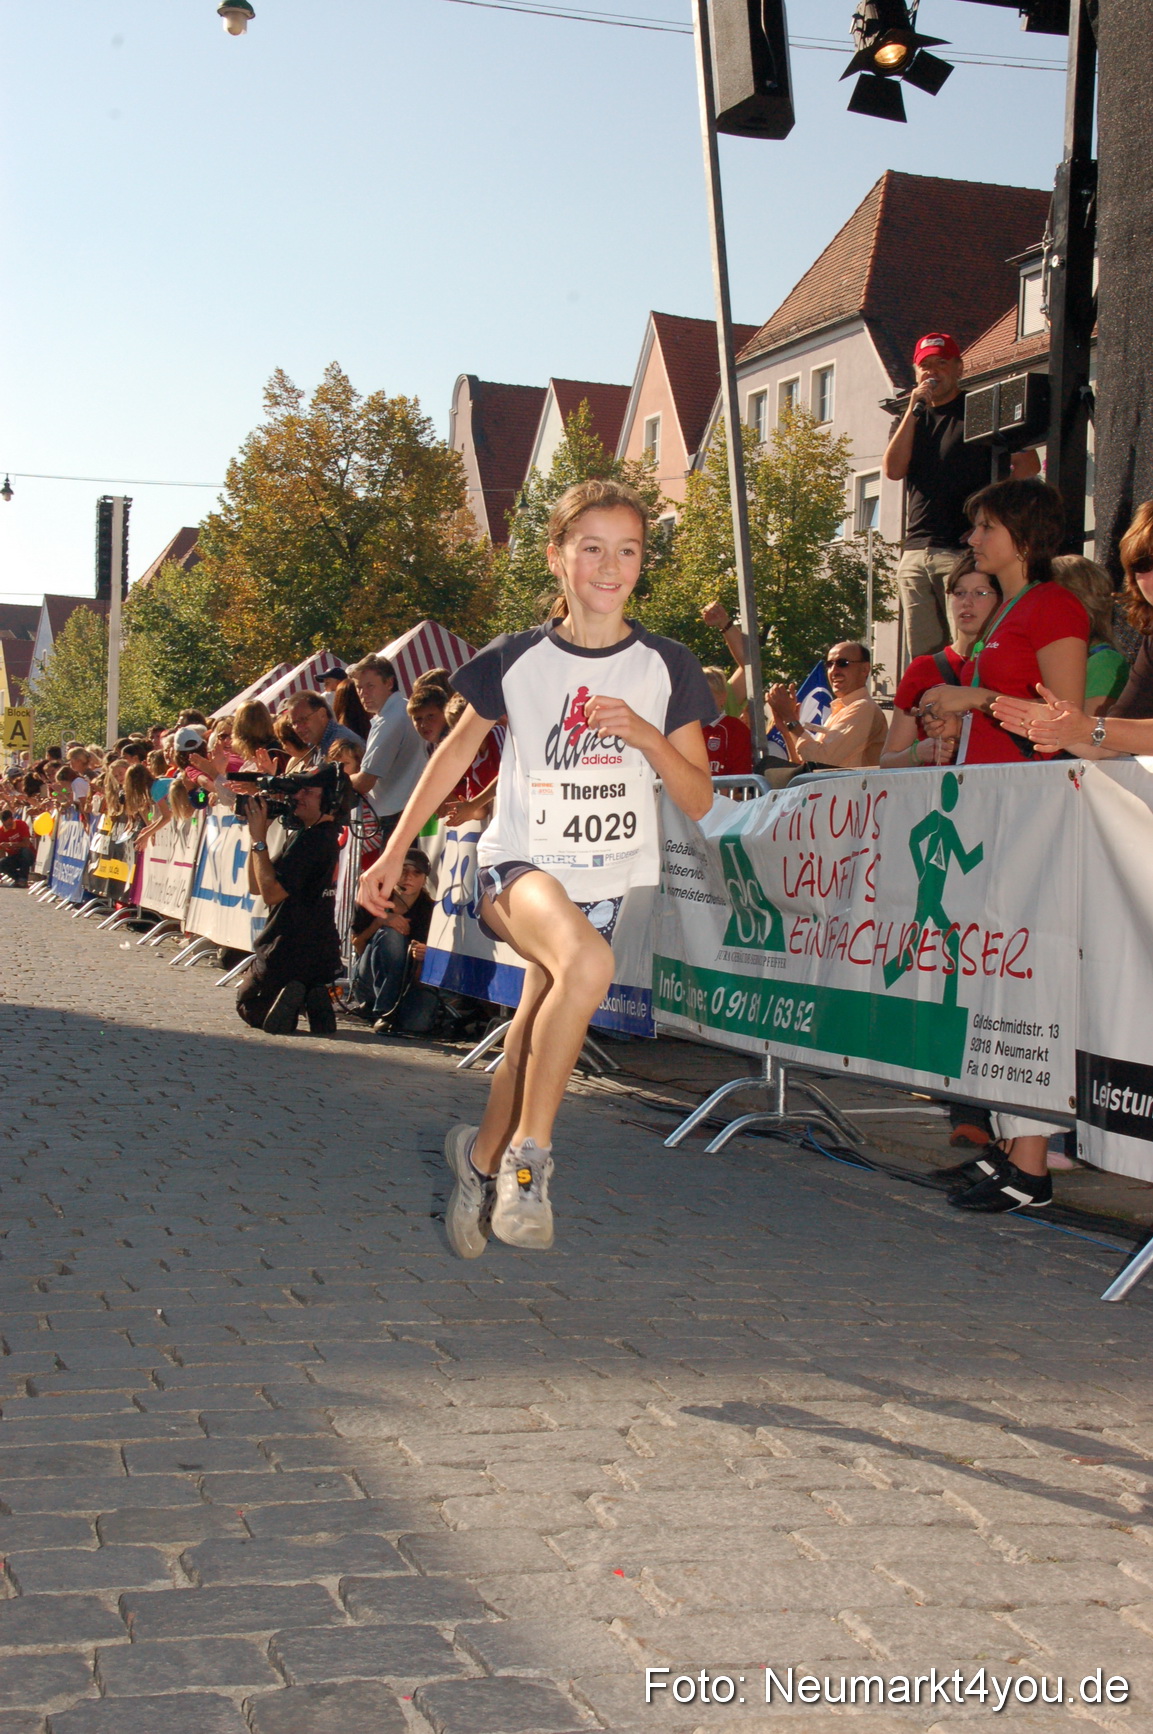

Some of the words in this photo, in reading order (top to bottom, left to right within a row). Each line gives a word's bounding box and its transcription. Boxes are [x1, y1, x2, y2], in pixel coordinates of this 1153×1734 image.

[7, 708, 31, 718] Block
[10, 719, 27, 741] A
[581, 754, 623, 765] adidas
[560, 782, 626, 800] Theresa
[536, 809, 546, 825] J
[829, 789, 888, 841] UNS
[562, 811, 637, 843] 4029
[897, 920, 1034, 980] BESSER.
[659, 969, 708, 1011] Info-ine:
[598, 994, 647, 1018] ckonline.de
[1048, 1023, 1060, 1039] 13
[994, 1040, 1049, 1062] Neumarkt
[981, 1063, 988, 1077] 0
[990, 1064, 1005, 1080] 91
[1035, 1071, 1051, 1086] 48
